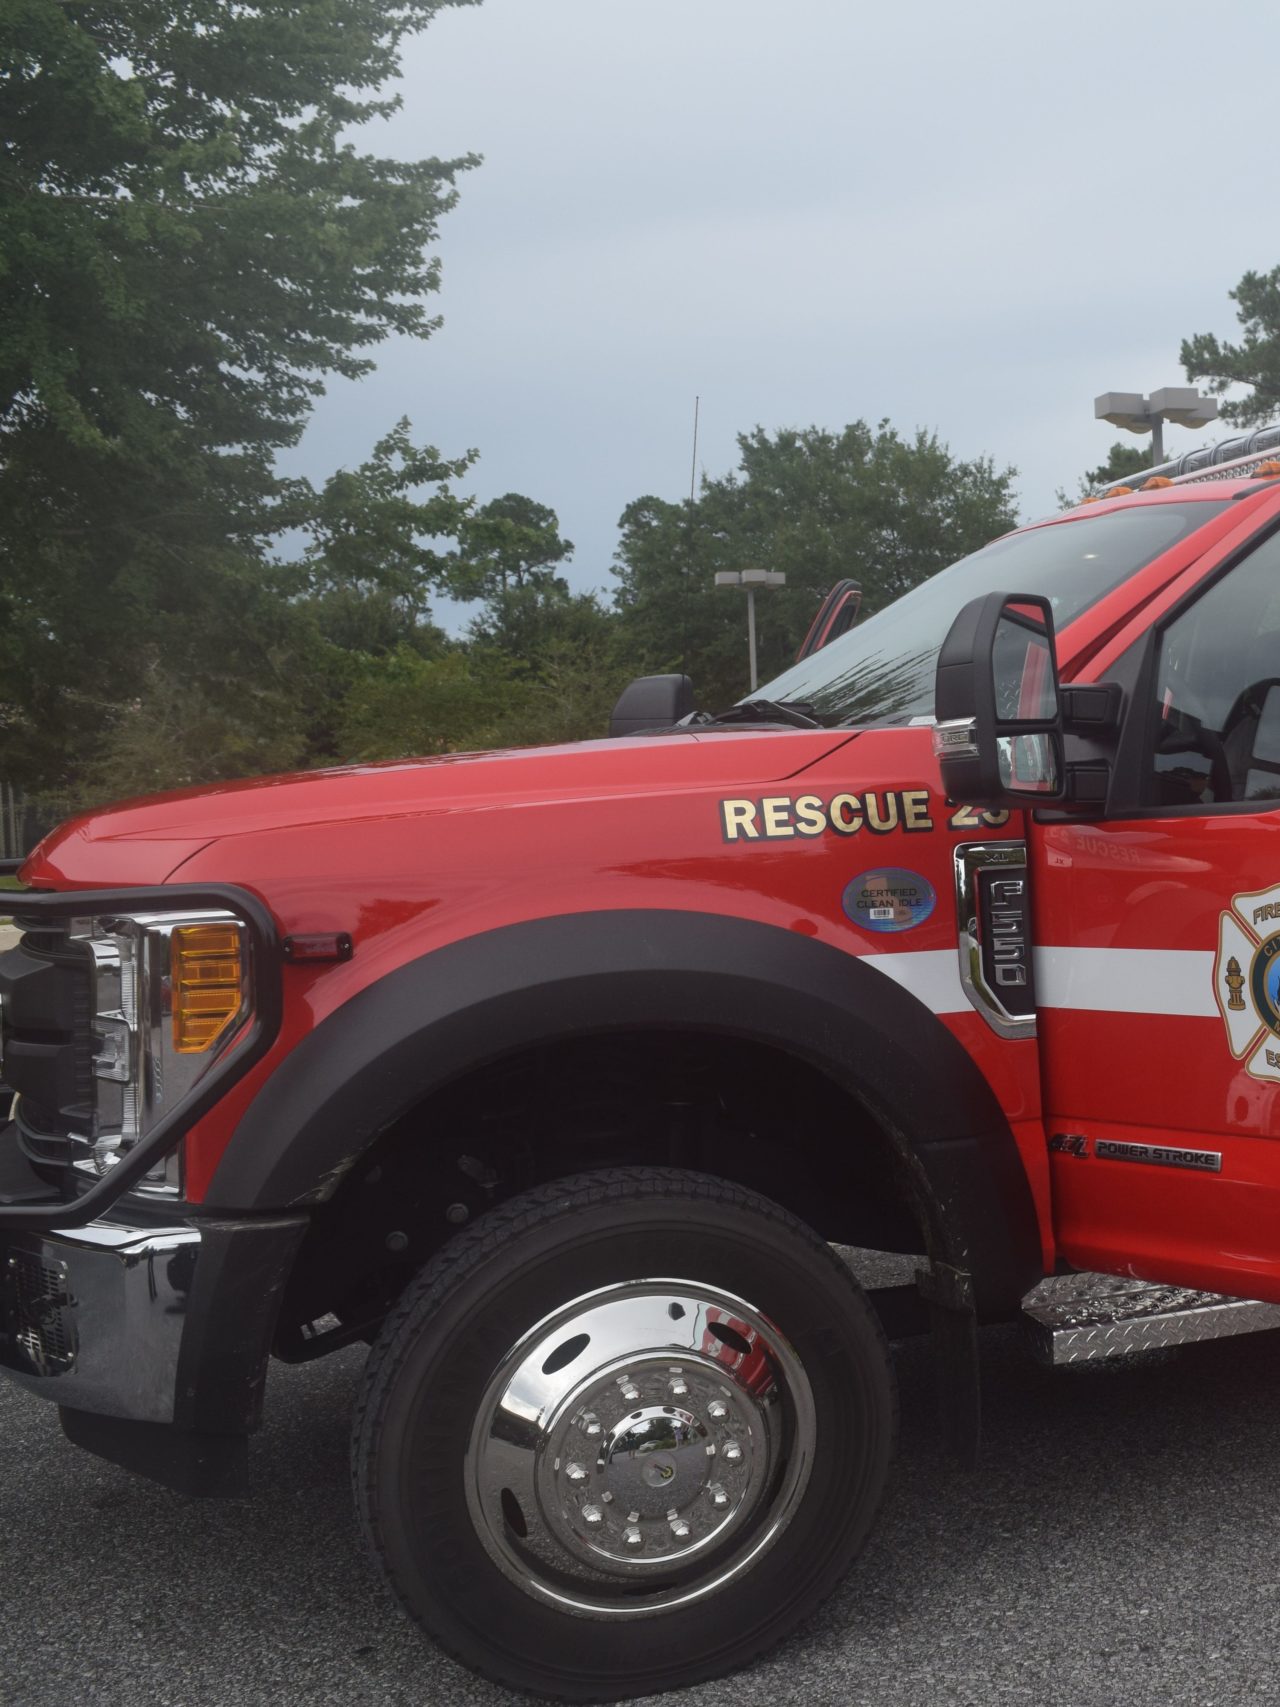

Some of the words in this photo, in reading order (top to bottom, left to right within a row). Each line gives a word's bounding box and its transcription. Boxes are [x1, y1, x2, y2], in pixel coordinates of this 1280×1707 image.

[722, 789, 934, 843] RESCUE
[861, 888, 917, 898] CERTIFIED
[856, 899, 894, 909] CLEAN
[898, 898, 923, 907] IDLE
[1097, 1141, 1149, 1158] POWER
[1152, 1148, 1216, 1166] STROKE
